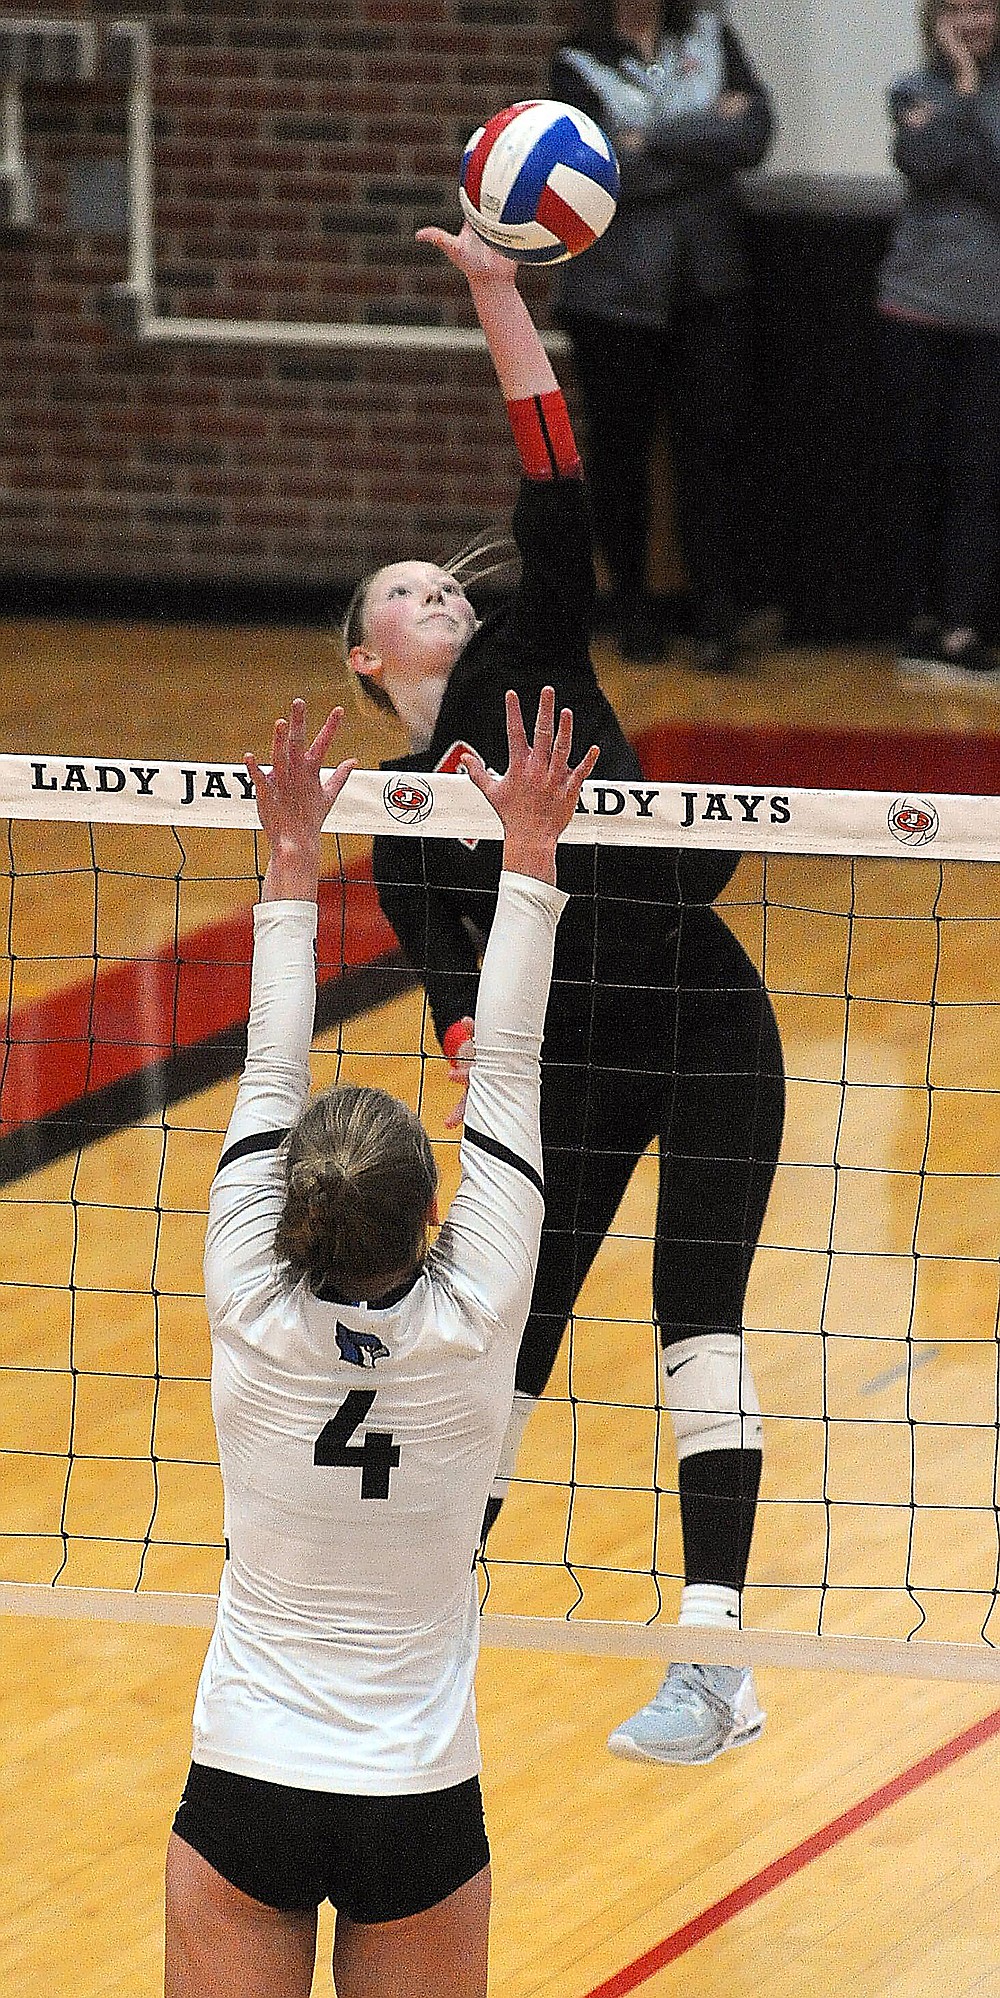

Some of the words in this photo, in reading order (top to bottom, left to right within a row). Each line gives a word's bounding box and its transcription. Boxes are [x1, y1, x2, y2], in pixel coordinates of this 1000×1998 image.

[31, 763, 159, 795] LADY
[180, 770, 257, 804] JAY
[575, 787, 660, 817] DY
[680, 792, 791, 827] JAYS
[313, 1389, 401, 1500] 4
